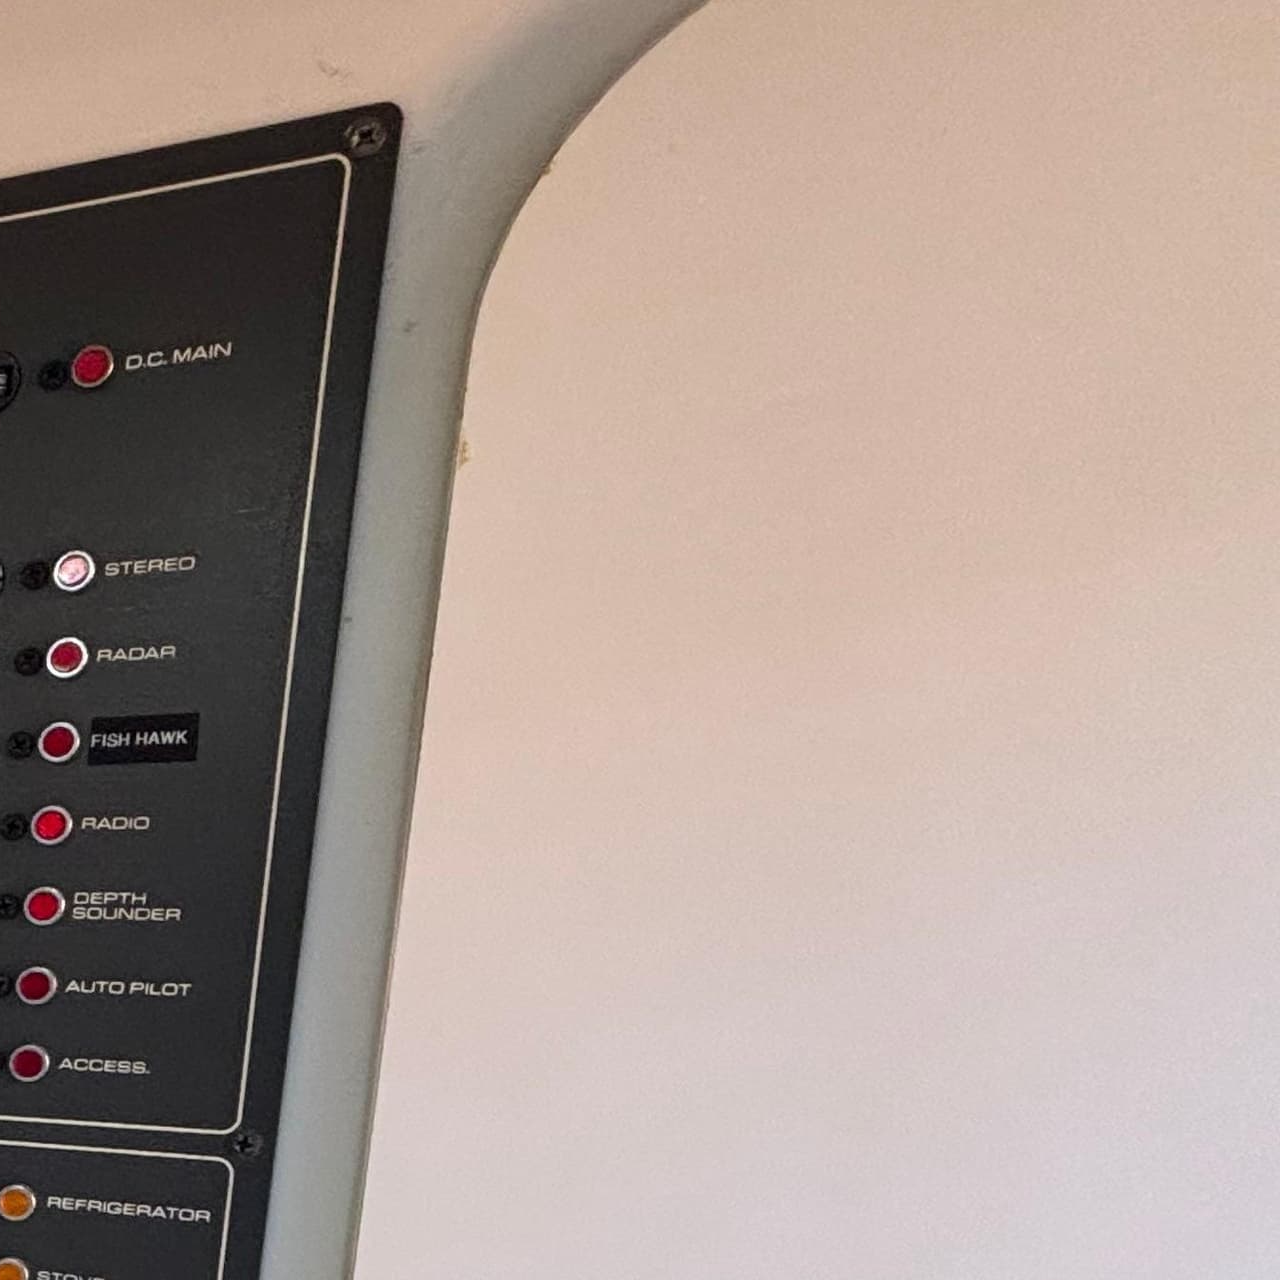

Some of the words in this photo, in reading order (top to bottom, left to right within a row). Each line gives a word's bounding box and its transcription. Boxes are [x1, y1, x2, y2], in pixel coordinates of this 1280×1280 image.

[126, 352, 167, 370] D.C.
[173, 342, 231, 363] MAIN
[105, 557, 195, 576] STEREO
[97, 646, 176, 662] RADAR
[91, 733, 130, 747] FISH
[135, 730, 187, 745] HAWK
[81, 816, 149, 830] RADIO
[74, 892, 146, 905] DEPTH
[72, 907, 181, 921] SOUNDER
[65, 980, 125, 994] AUTO
[129, 982, 191, 996] PILOT
[59, 1058, 150, 1074] ACCESS.
[47, 1197, 210, 1222] REFRIGERATOR
